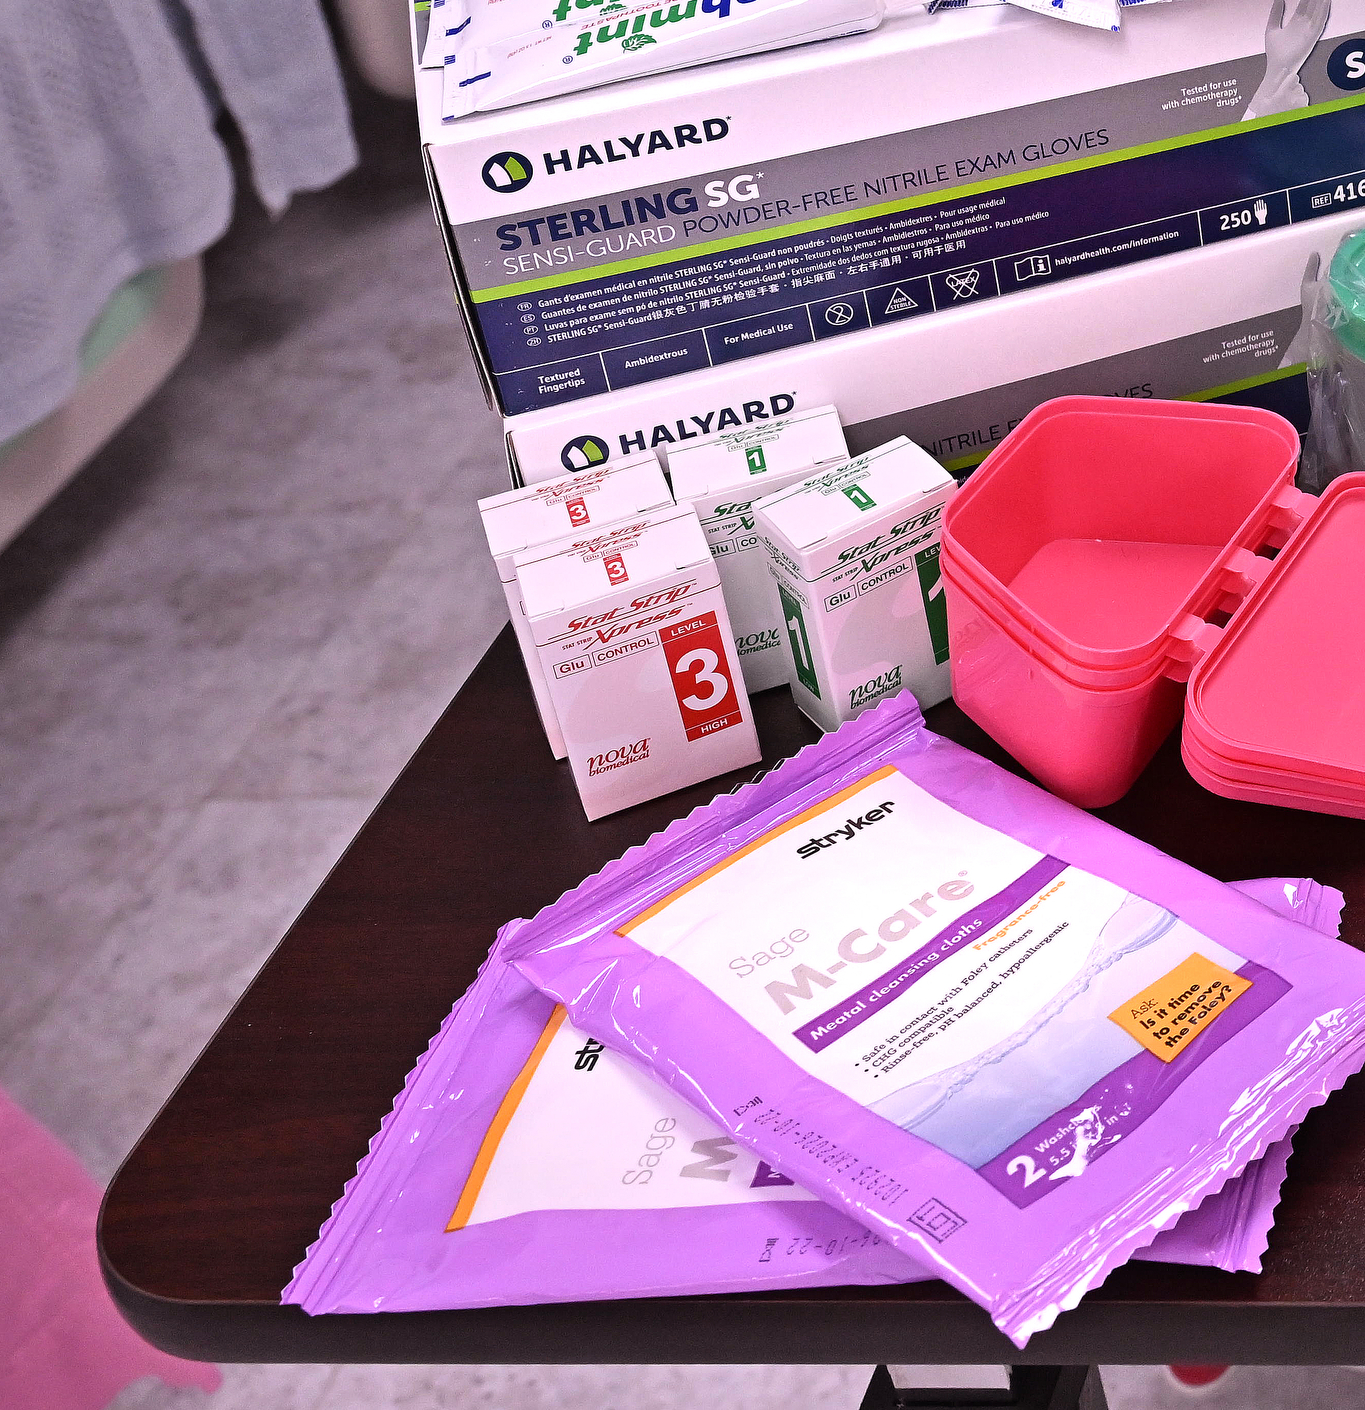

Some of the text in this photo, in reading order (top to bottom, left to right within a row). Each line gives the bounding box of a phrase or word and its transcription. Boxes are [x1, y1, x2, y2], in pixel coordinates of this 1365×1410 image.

[1345, 51, 1365, 78] S
[1162, 88, 1238, 110] with chemotherapy
[1181, 79, 1236, 96] Tested for use
[495, 187, 699, 251] STERLING
[503, 129, 1109, 275] SENSI-GUARD POWDER-FREE NITRILE EXAM GLOVES
[1314, 195, 1330, 206] REF
[1219, 209, 1252, 232] 250
[537, 297, 562, 307] Gants
[563, 288, 602, 302] d'examen
[603, 279, 636, 294] médical
[648, 272, 673, 284] nitrile
[674, 263, 712, 278] STERLING
[728, 248, 776, 266] Sensi-Guard
[777, 246, 793, 255] non
[793, 238, 825, 253] poudrés
[830, 232, 854, 243] Doigts
[854, 225, 883, 238] texturés
[889, 215, 933, 230] Ambidextres
[939, 209, 956, 218] Pour
[956, 204, 977, 214] usage
[978, 196, 1005, 209] médical
[1055, 230, 1179, 267] halyardhealth.com/information
[724, 322, 794, 346] For Medical Use
[538, 369, 580, 385] Textured
[624, 348, 688, 370] Ambidextrous
[538, 378, 586, 395] Fingertips
[748, 452, 761, 467] 1
[570, 504, 588, 521] 3
[851, 491, 868, 505] 1
[837, 508, 941, 564] Stat Strip
[608, 562, 626, 578] 3
[829, 562, 910, 607] Glu CONTROL
[568, 582, 692, 632] Stat Strip
[584, 606, 685, 651] Xpress
[670, 620, 706, 637] LEVEL
[789, 616, 810, 670] 1
[559, 636, 654, 674] Glu CONTROL
[674, 648, 729, 710] 3
[849, 665, 902, 701] nova
[850, 677, 902, 709] biomedical
[700, 718, 728, 734] HIGH
[586, 738, 651, 769] nova
[589, 750, 650, 776] biomedical
[797, 800, 896, 859] stryker
[972, 880, 1066, 951] Fragrance-free
[728, 925, 810, 978] Sage
[763, 879, 975, 1017] M-Care
[810, 918, 982, 1040] Meatal cleansing cloths
[862, 928, 1033, 1064] Safe in contact with Foley catheters
[881, 921, 1070, 1074] Rinse-free, pH balanced, hypoallergenic
[1130, 998, 1158, 1020] Ask:
[1140, 984, 1200, 1030] Is it time
[1152, 980, 1222, 1040] to remove
[1164, 984, 1233, 1049] the Foley?
[872, 1006, 954, 1068] CHG compatible
[622, 1116, 676, 1186] Sage
[1050, 1148, 1071, 1166] 5.5
[1006, 1154, 1046, 1189] 2
